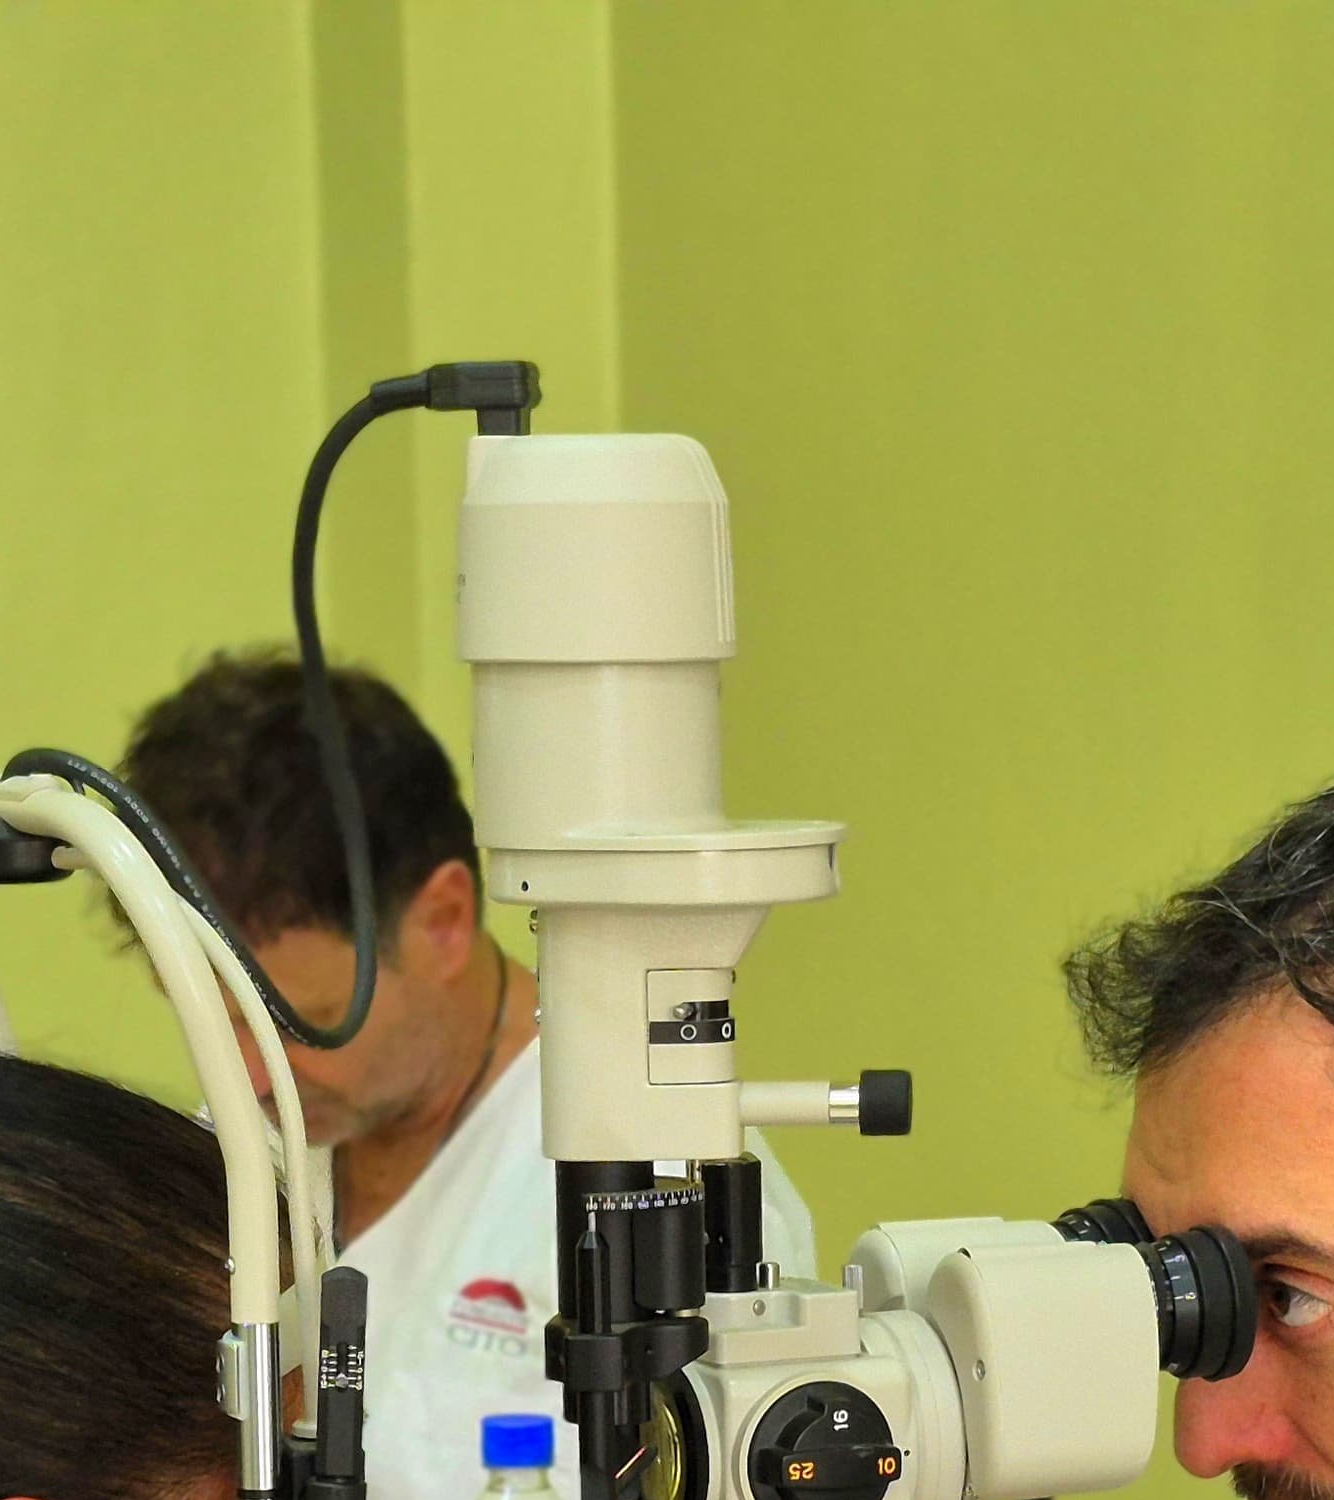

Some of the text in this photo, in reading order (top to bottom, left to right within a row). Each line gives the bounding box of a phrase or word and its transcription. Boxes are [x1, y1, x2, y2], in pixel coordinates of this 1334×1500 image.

[833, 1409, 849, 1431] 16
[788, 1462, 814, 1480] 25
[877, 1457, 896, 1475] 10
